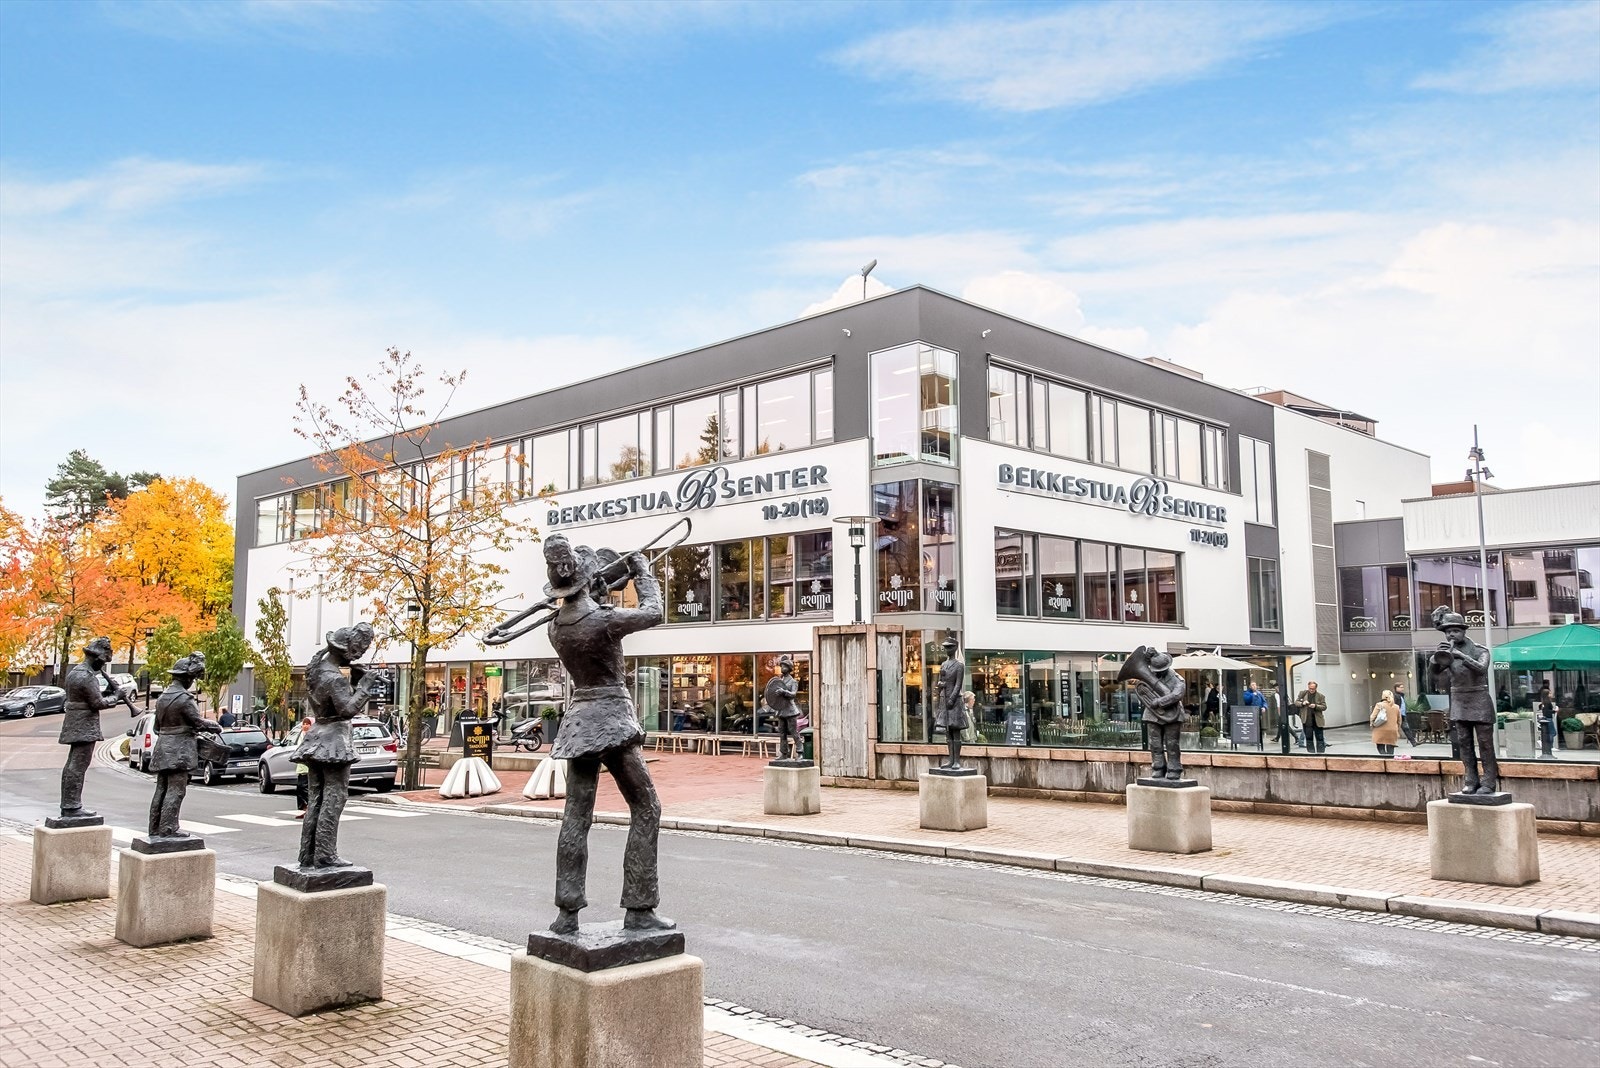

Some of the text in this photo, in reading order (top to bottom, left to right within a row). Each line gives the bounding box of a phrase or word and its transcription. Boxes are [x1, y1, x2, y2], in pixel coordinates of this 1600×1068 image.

[547, 490, 674, 526] BEKKESTUA
[720, 464, 829, 499] SENTER
[998, 463, 1129, 505] BEKKESTUA
[1162, 495, 1228, 523] SENTER
[1392, 620, 1411, 628] EGO
